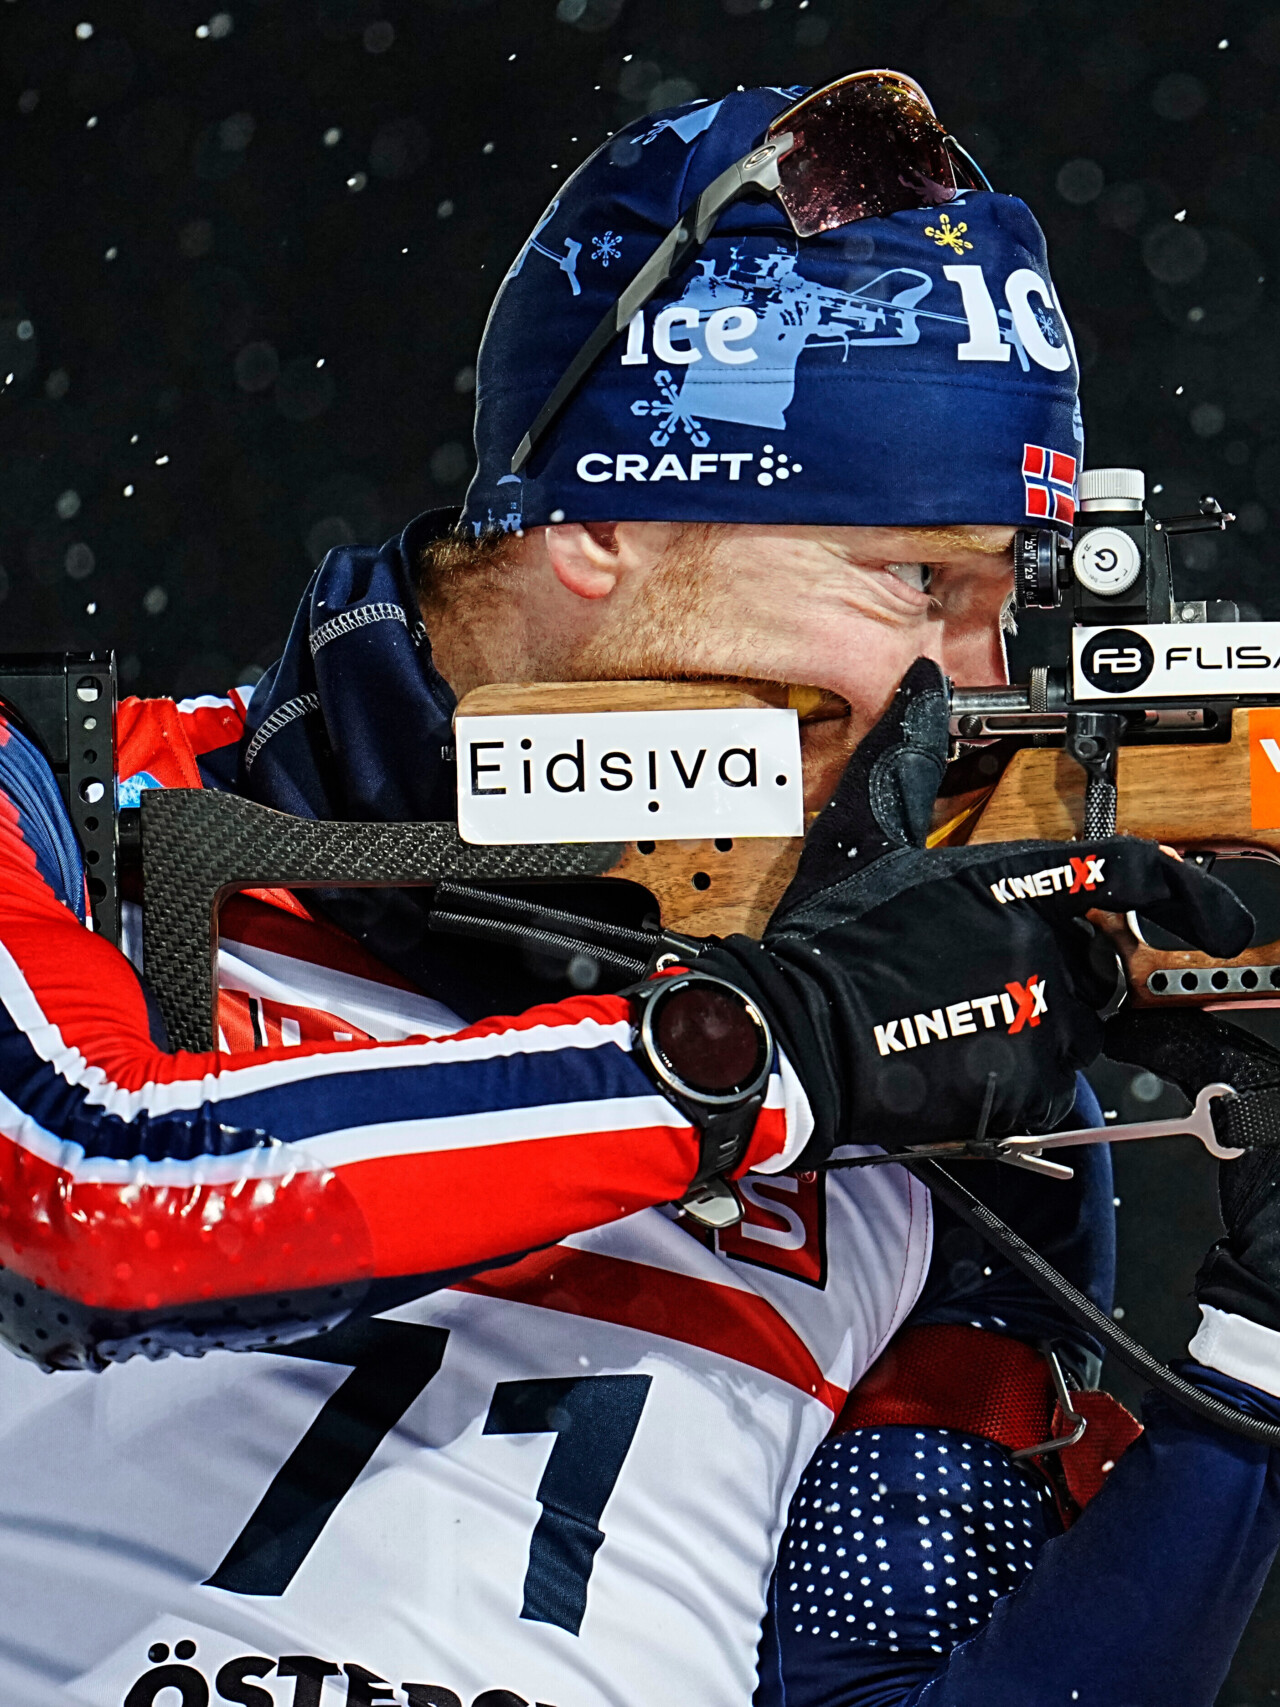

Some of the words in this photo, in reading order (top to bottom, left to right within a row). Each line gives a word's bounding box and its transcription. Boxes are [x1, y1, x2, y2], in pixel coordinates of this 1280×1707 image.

[620, 305, 759, 367] ice
[576, 453, 753, 483] CRAFT
[990, 855, 1105, 904] KINETIXX
[873, 974, 1048, 1056] KINETIXX
